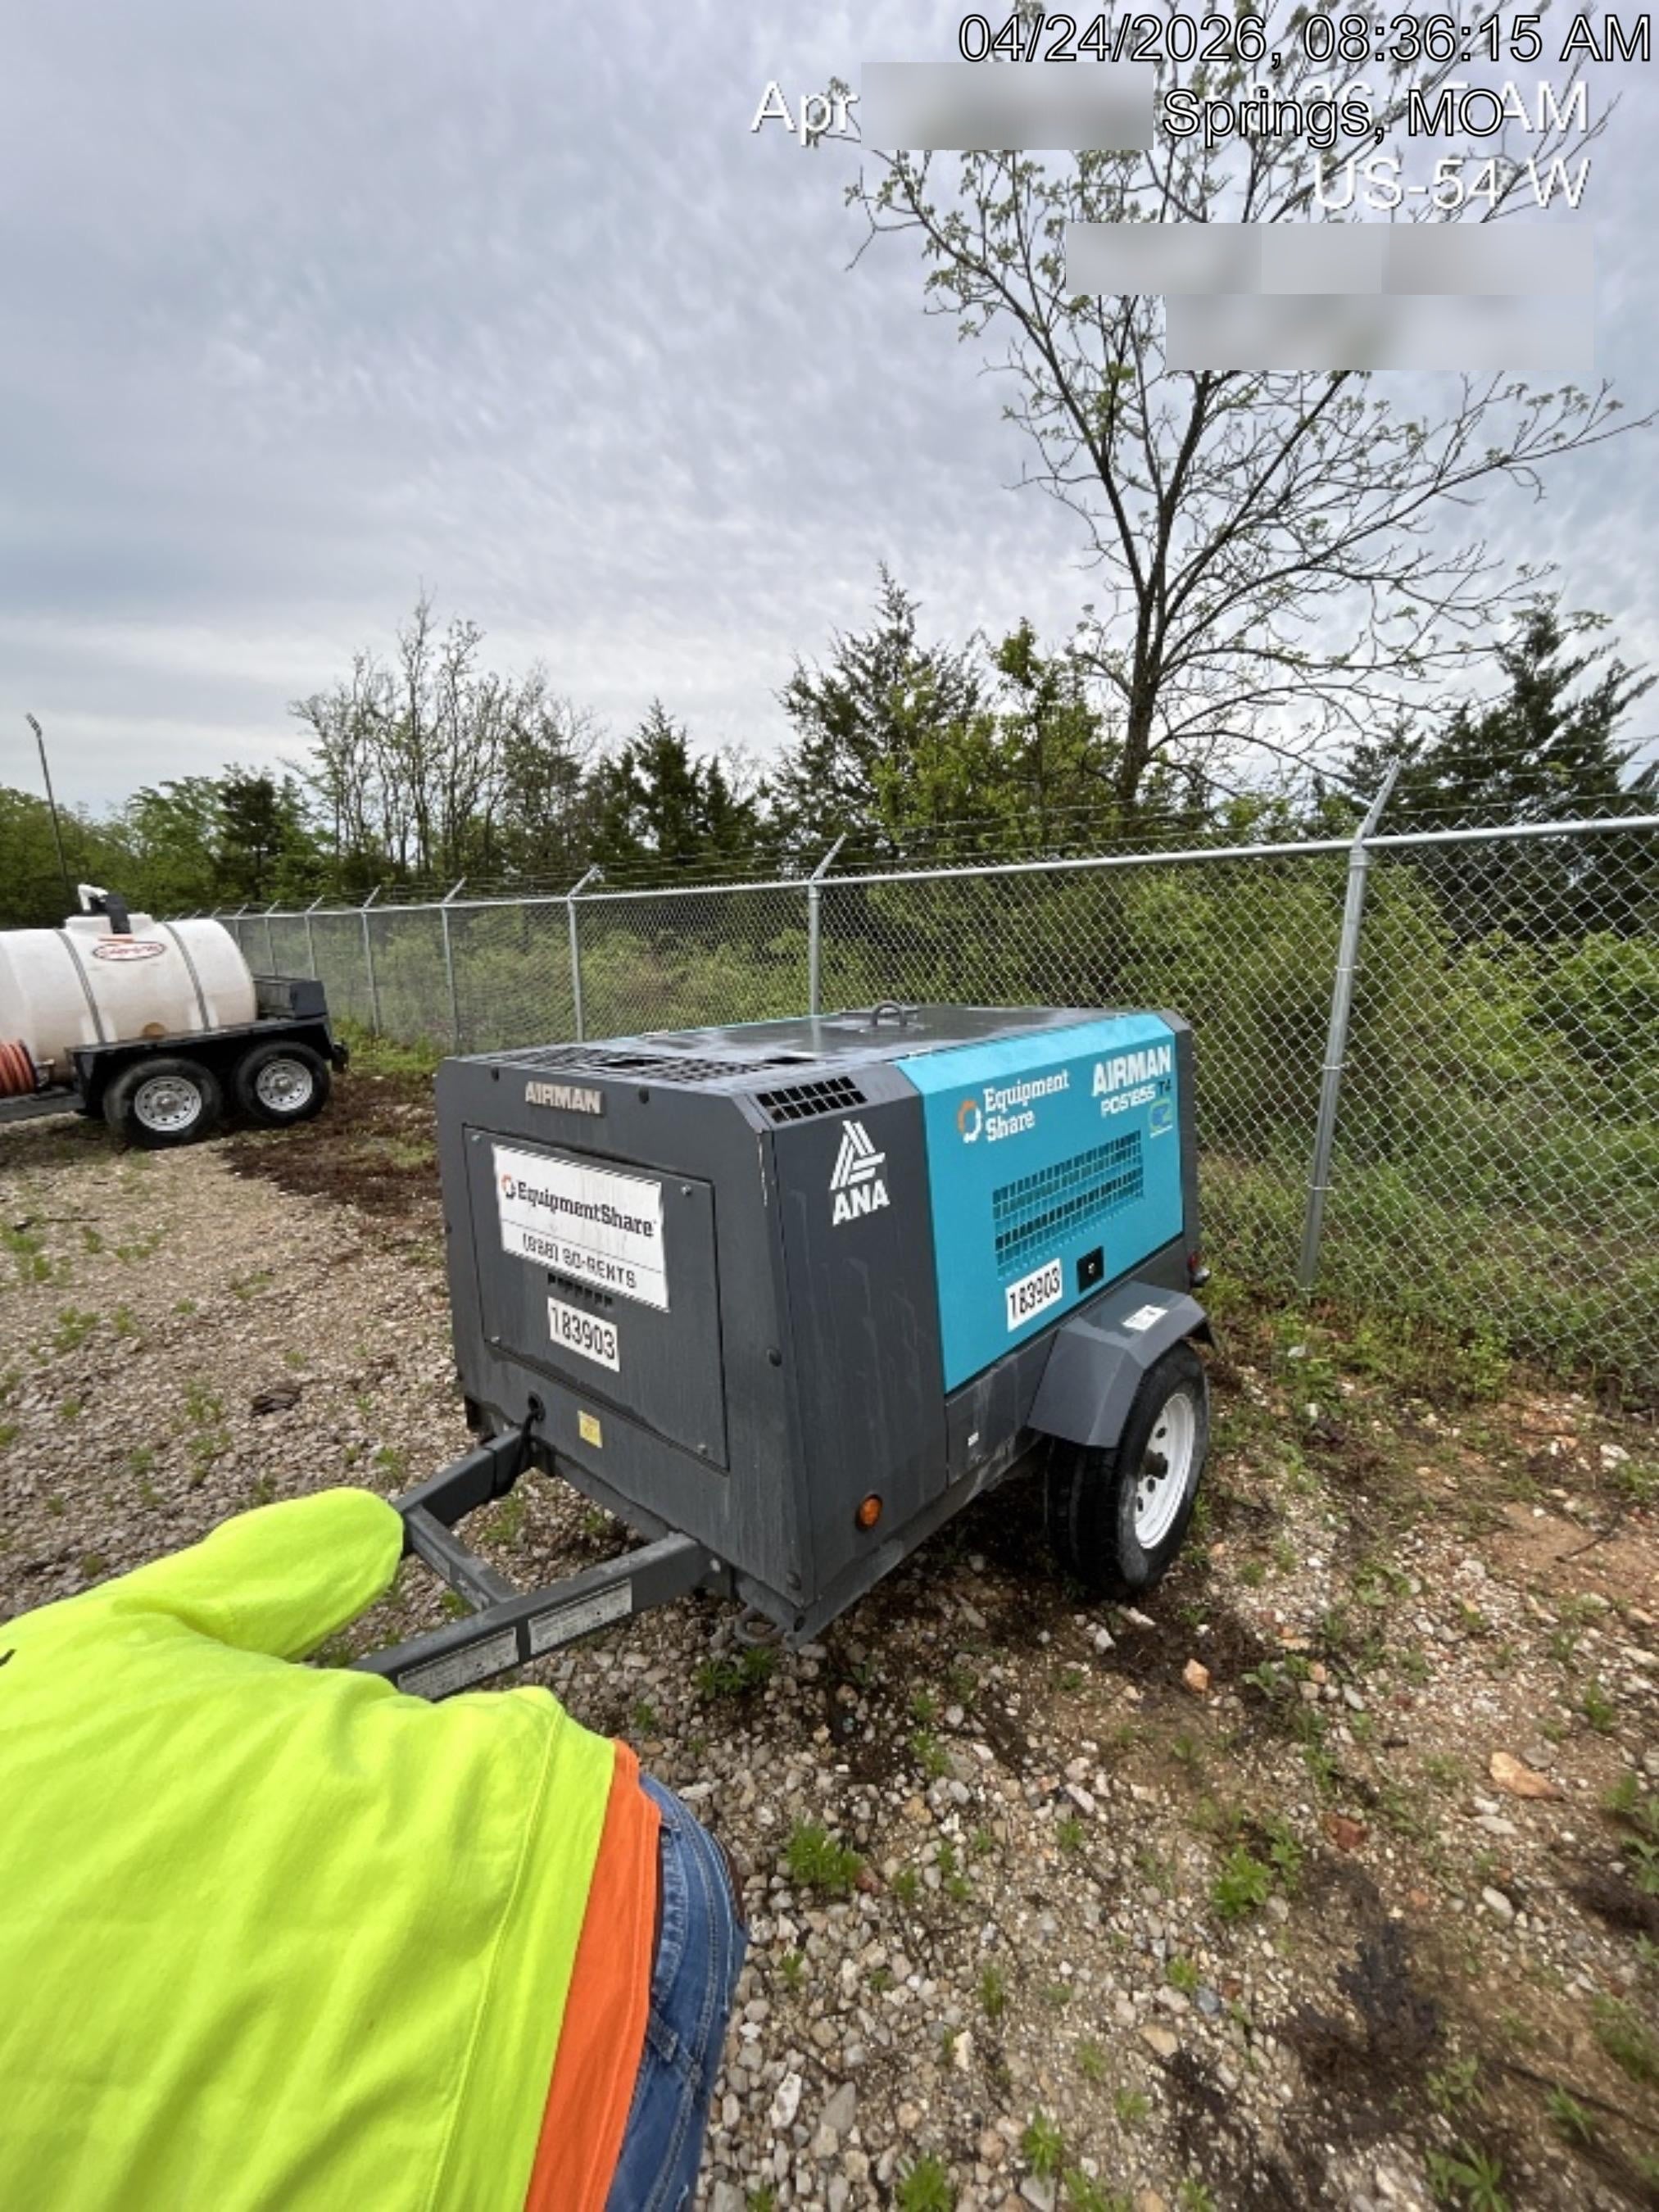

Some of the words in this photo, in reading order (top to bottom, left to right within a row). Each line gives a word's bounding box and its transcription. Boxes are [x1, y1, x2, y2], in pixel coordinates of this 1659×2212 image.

[983, 1067, 1070, 1114] Equipment
[1090, 1044, 1172, 1098] AIRMAN
[525, 1080, 602, 1114] AIRMAN
[985, 1109, 1036, 1142] Share
[517, 1179, 655, 1238] EquipmentShare
[832, 1179, 891, 1227] ANA
[1009, 1266, 1060, 1321] 183903
[551, 1306, 615, 1360] 183903
